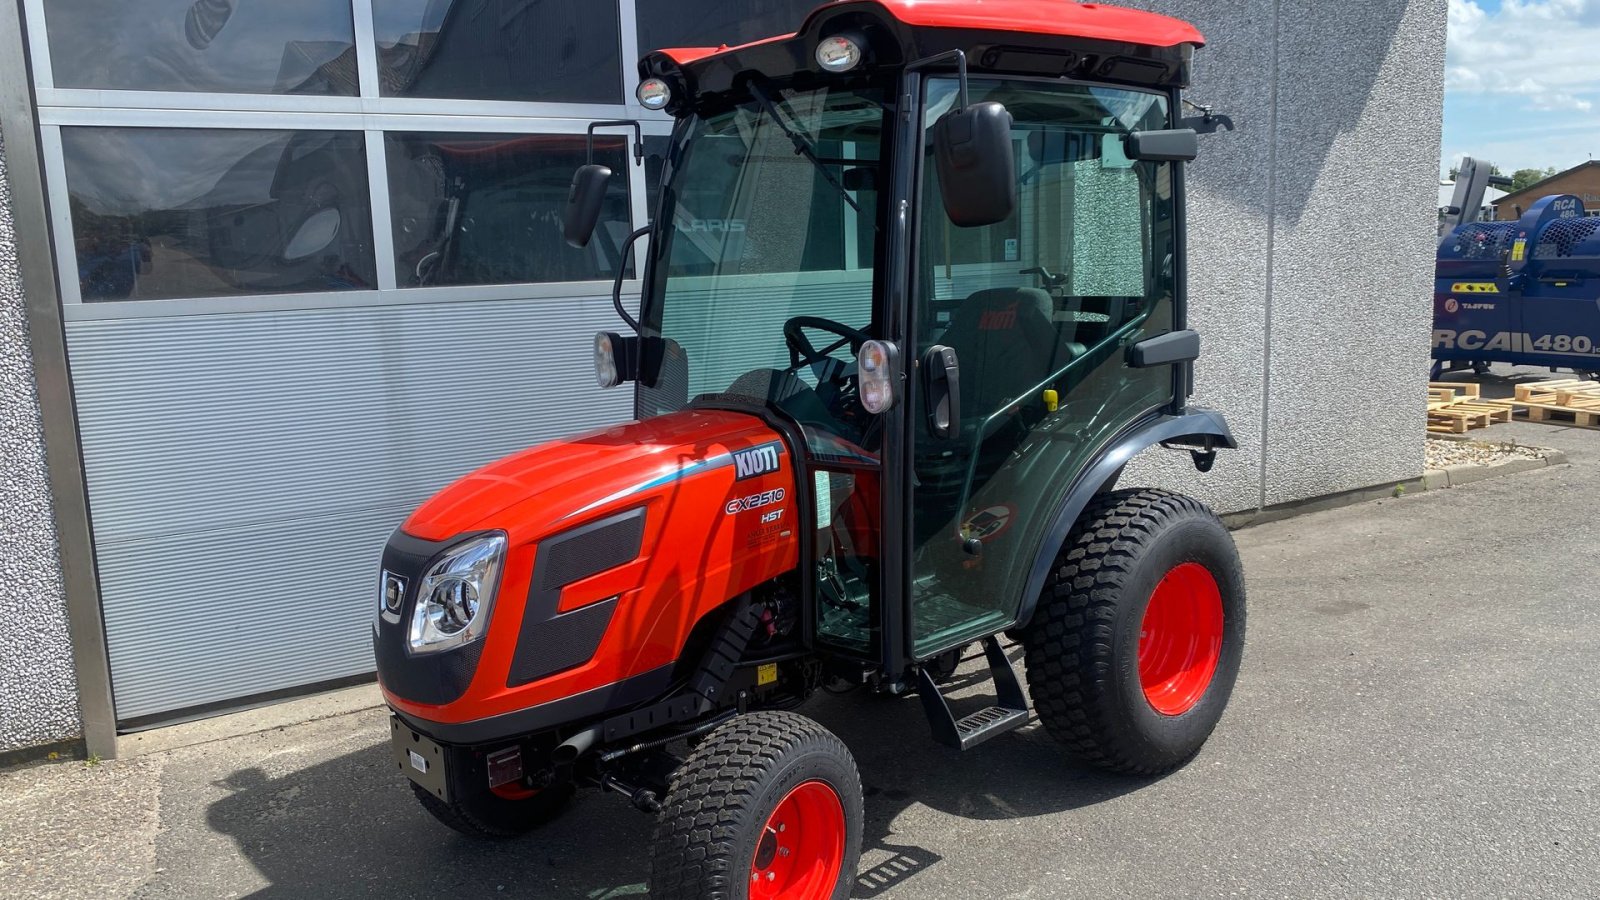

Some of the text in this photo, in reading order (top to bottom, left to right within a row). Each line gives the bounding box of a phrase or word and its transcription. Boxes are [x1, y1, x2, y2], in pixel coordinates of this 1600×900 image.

[1553, 199, 1576, 211] RCA
[1560, 209, 1575, 219] 480
[674, 218, 746, 232] LARIS
[1533, 334, 1592, 353] 480
[734, 445, 779, 478] KIOTI
[726, 487, 785, 515] CX2510
[761, 508, 784, 524] HST
